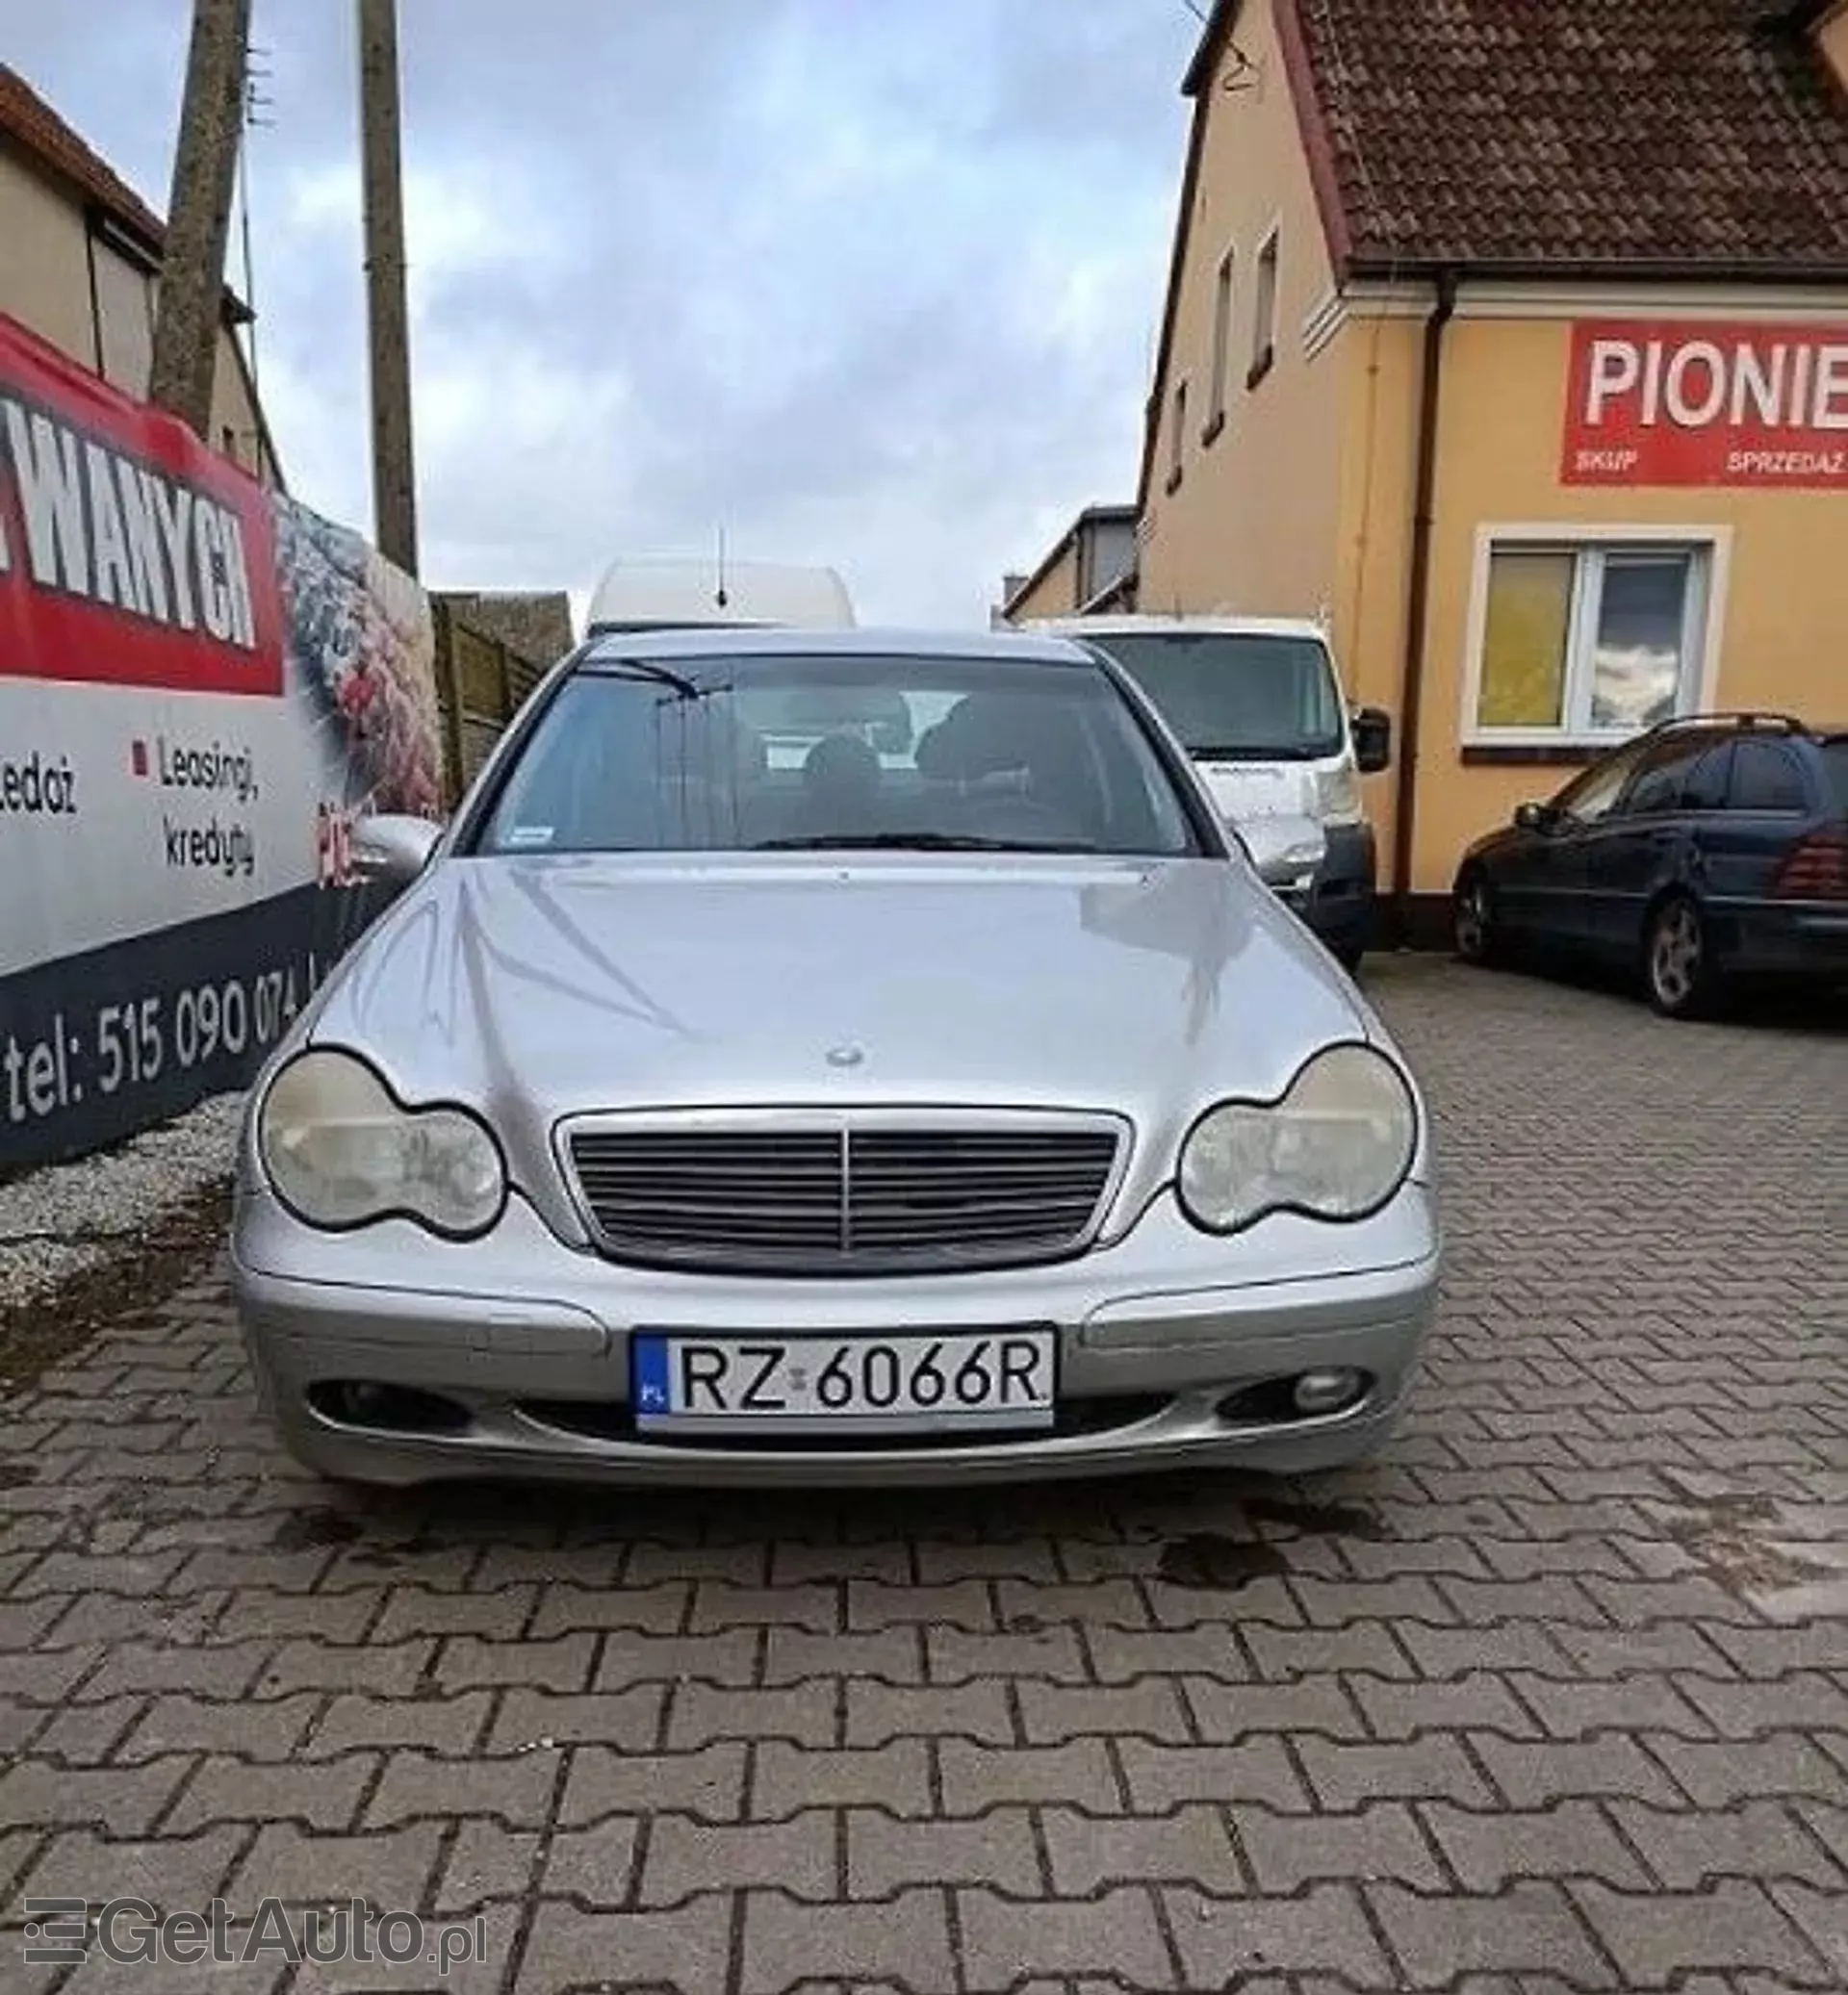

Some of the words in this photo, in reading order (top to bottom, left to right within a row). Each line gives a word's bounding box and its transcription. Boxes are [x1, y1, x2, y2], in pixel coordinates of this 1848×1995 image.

[1585, 340, 1848, 428] PIONIE
[1576, 449, 1638, 472] SKUP
[0, 397, 256, 650] WANYCH
[0, 751, 77, 814] edaż
[163, 814, 254, 878] kredyty
[5, 1013, 82, 1122] tel:
[99, 997, 163, 1093] 515
[176, 980, 247, 1067] 090
[680, 1346, 786, 1409] RZ
[816, 1342, 1040, 1408] 6066R
